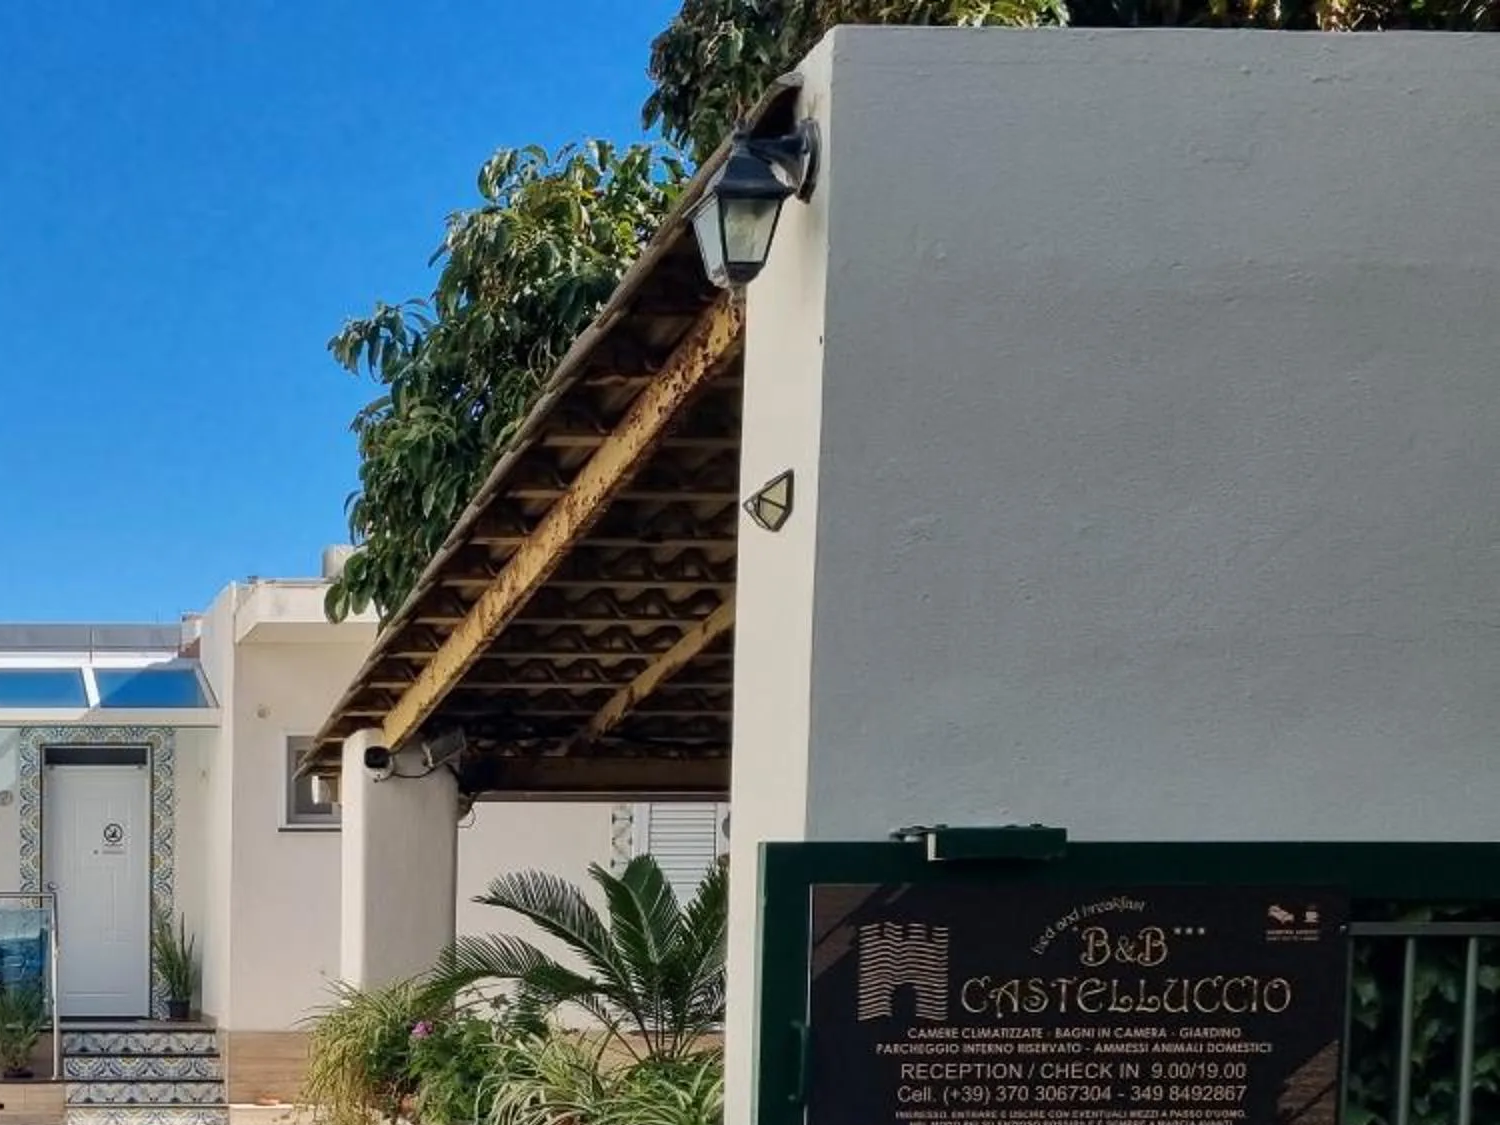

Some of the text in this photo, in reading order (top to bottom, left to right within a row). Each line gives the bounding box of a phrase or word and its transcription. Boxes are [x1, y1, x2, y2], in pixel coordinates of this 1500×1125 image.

[1030, 895, 1146, 954] bed and breakfast
[1079, 925, 1169, 967] B&B
[960, 974, 1292, 1019] CASTELLUCCIO
[907, 1027, 959, 1039] CAMERE
[961, 1027, 1043, 1039] CLIMATIZZATE
[1055, 1027, 1096, 1039] BAGNI
[1097, 1027, 1111, 1039] IN
[1114, 1027, 1167, 1039] CAMERA
[1179, 1027, 1242, 1039] GIARDINO
[875, 1042, 960, 1054] PARCHEGGIO
[962, 1042, 1014, 1054] INTERNO
[1017, 1042, 1082, 1054] RISERVATO
[1093, 1042, 1149, 1054] AMMESSI
[1151, 1042, 1203, 1053] ANIMALI
[1206, 1042, 1273, 1053] DOMESTICI
[900, 1062, 1023, 1080] RECEPTION
[1040, 1062, 1114, 1080] CHECK
[1119, 1062, 1140, 1080] IN
[1151, 1062, 1247, 1080] 9.00/19.00
[897, 1085, 937, 1102] Cell.
[943, 1084, 991, 1105] (+39)
[996, 1085, 1029, 1102] 370
[1035, 1085, 1112, 1102] 3067304
[1131, 1085, 1163, 1102] 349
[1168, 1085, 1247, 1102] 8492867
